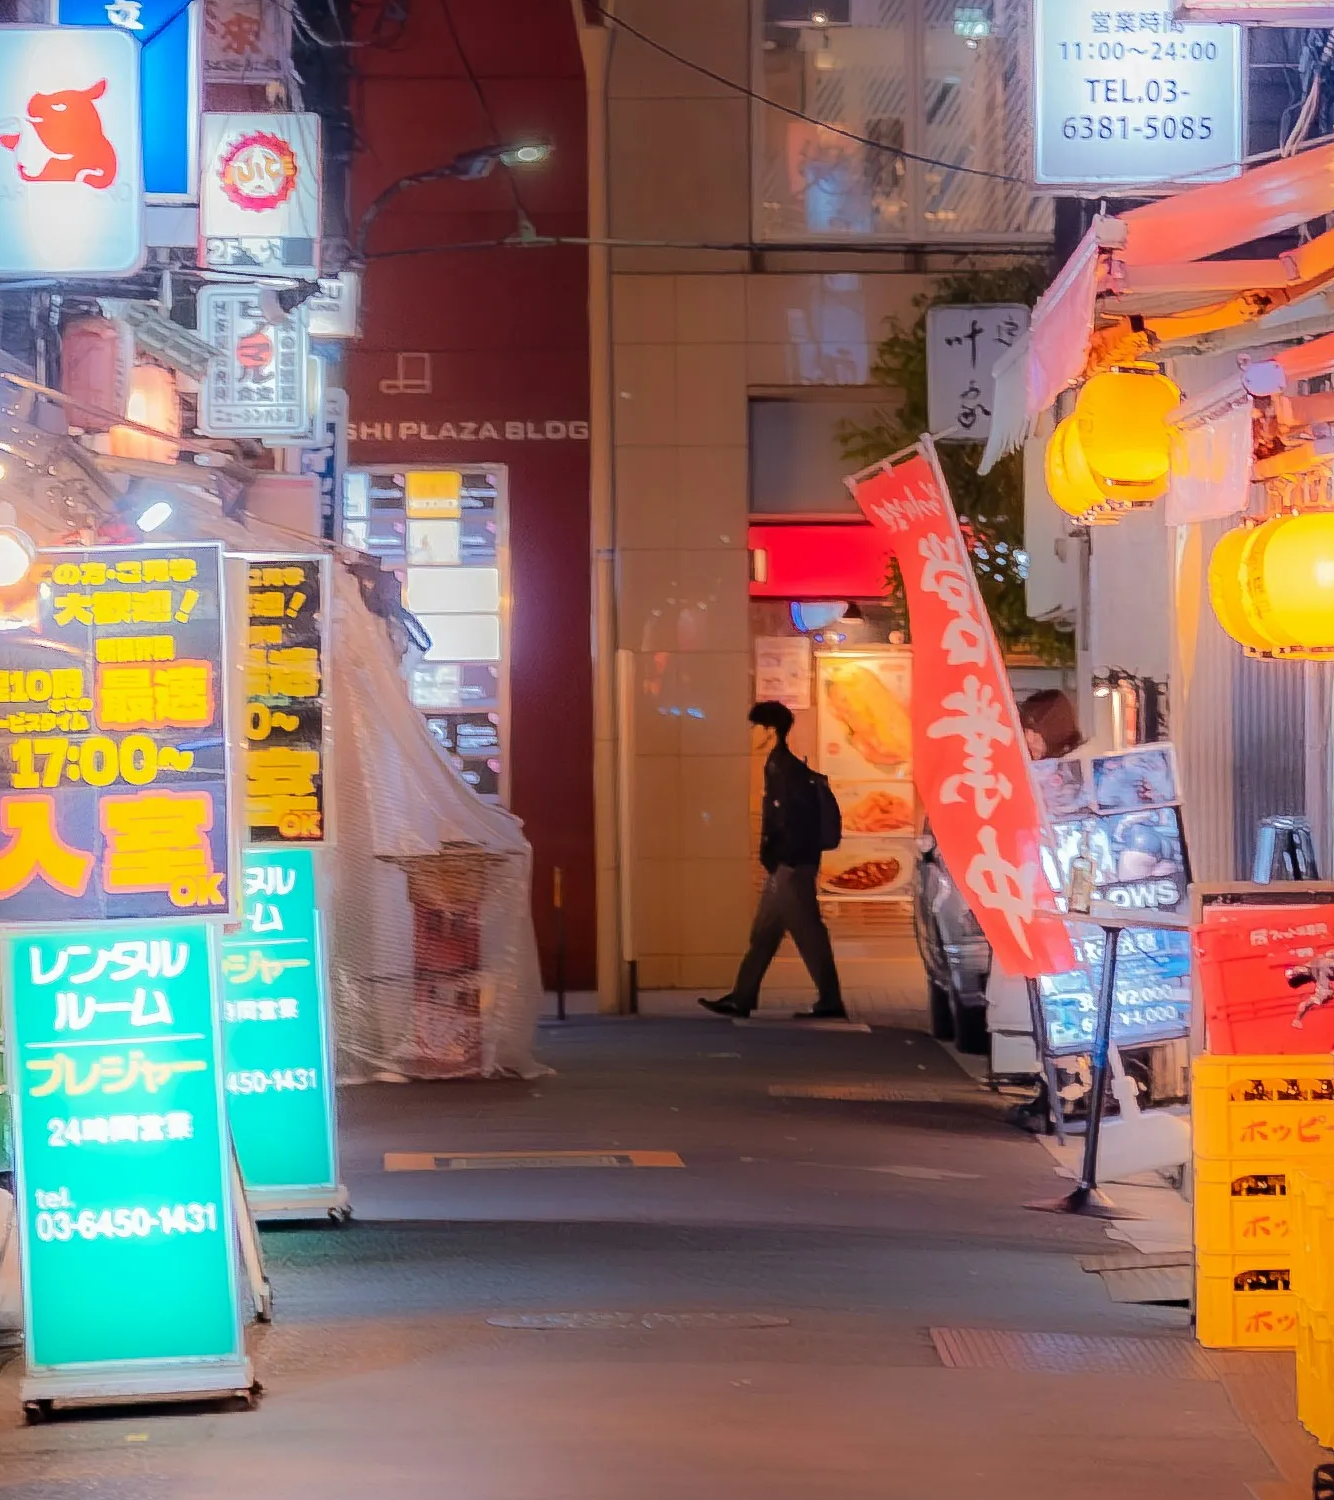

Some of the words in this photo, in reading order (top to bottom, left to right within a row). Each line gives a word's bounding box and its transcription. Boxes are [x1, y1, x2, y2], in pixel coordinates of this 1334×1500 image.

[1086, 78, 1191, 104] TEL.03-
[1063, 114, 1213, 141] 6381-5085
[398, 421, 499, 441] PLAZA
[504, 420, 590, 440] BLDG
[279, 810, 323, 840] OK
[168, 873, 227, 908] OK
[28, 939, 191, 986] レンタル
[54, 986, 174, 1033] ルーム
[24, 1051, 208, 1098] プレジャー
[47, 1110, 195, 1149] 24時間営業
[35, 1202, 217, 1242] 03-6450-1431
